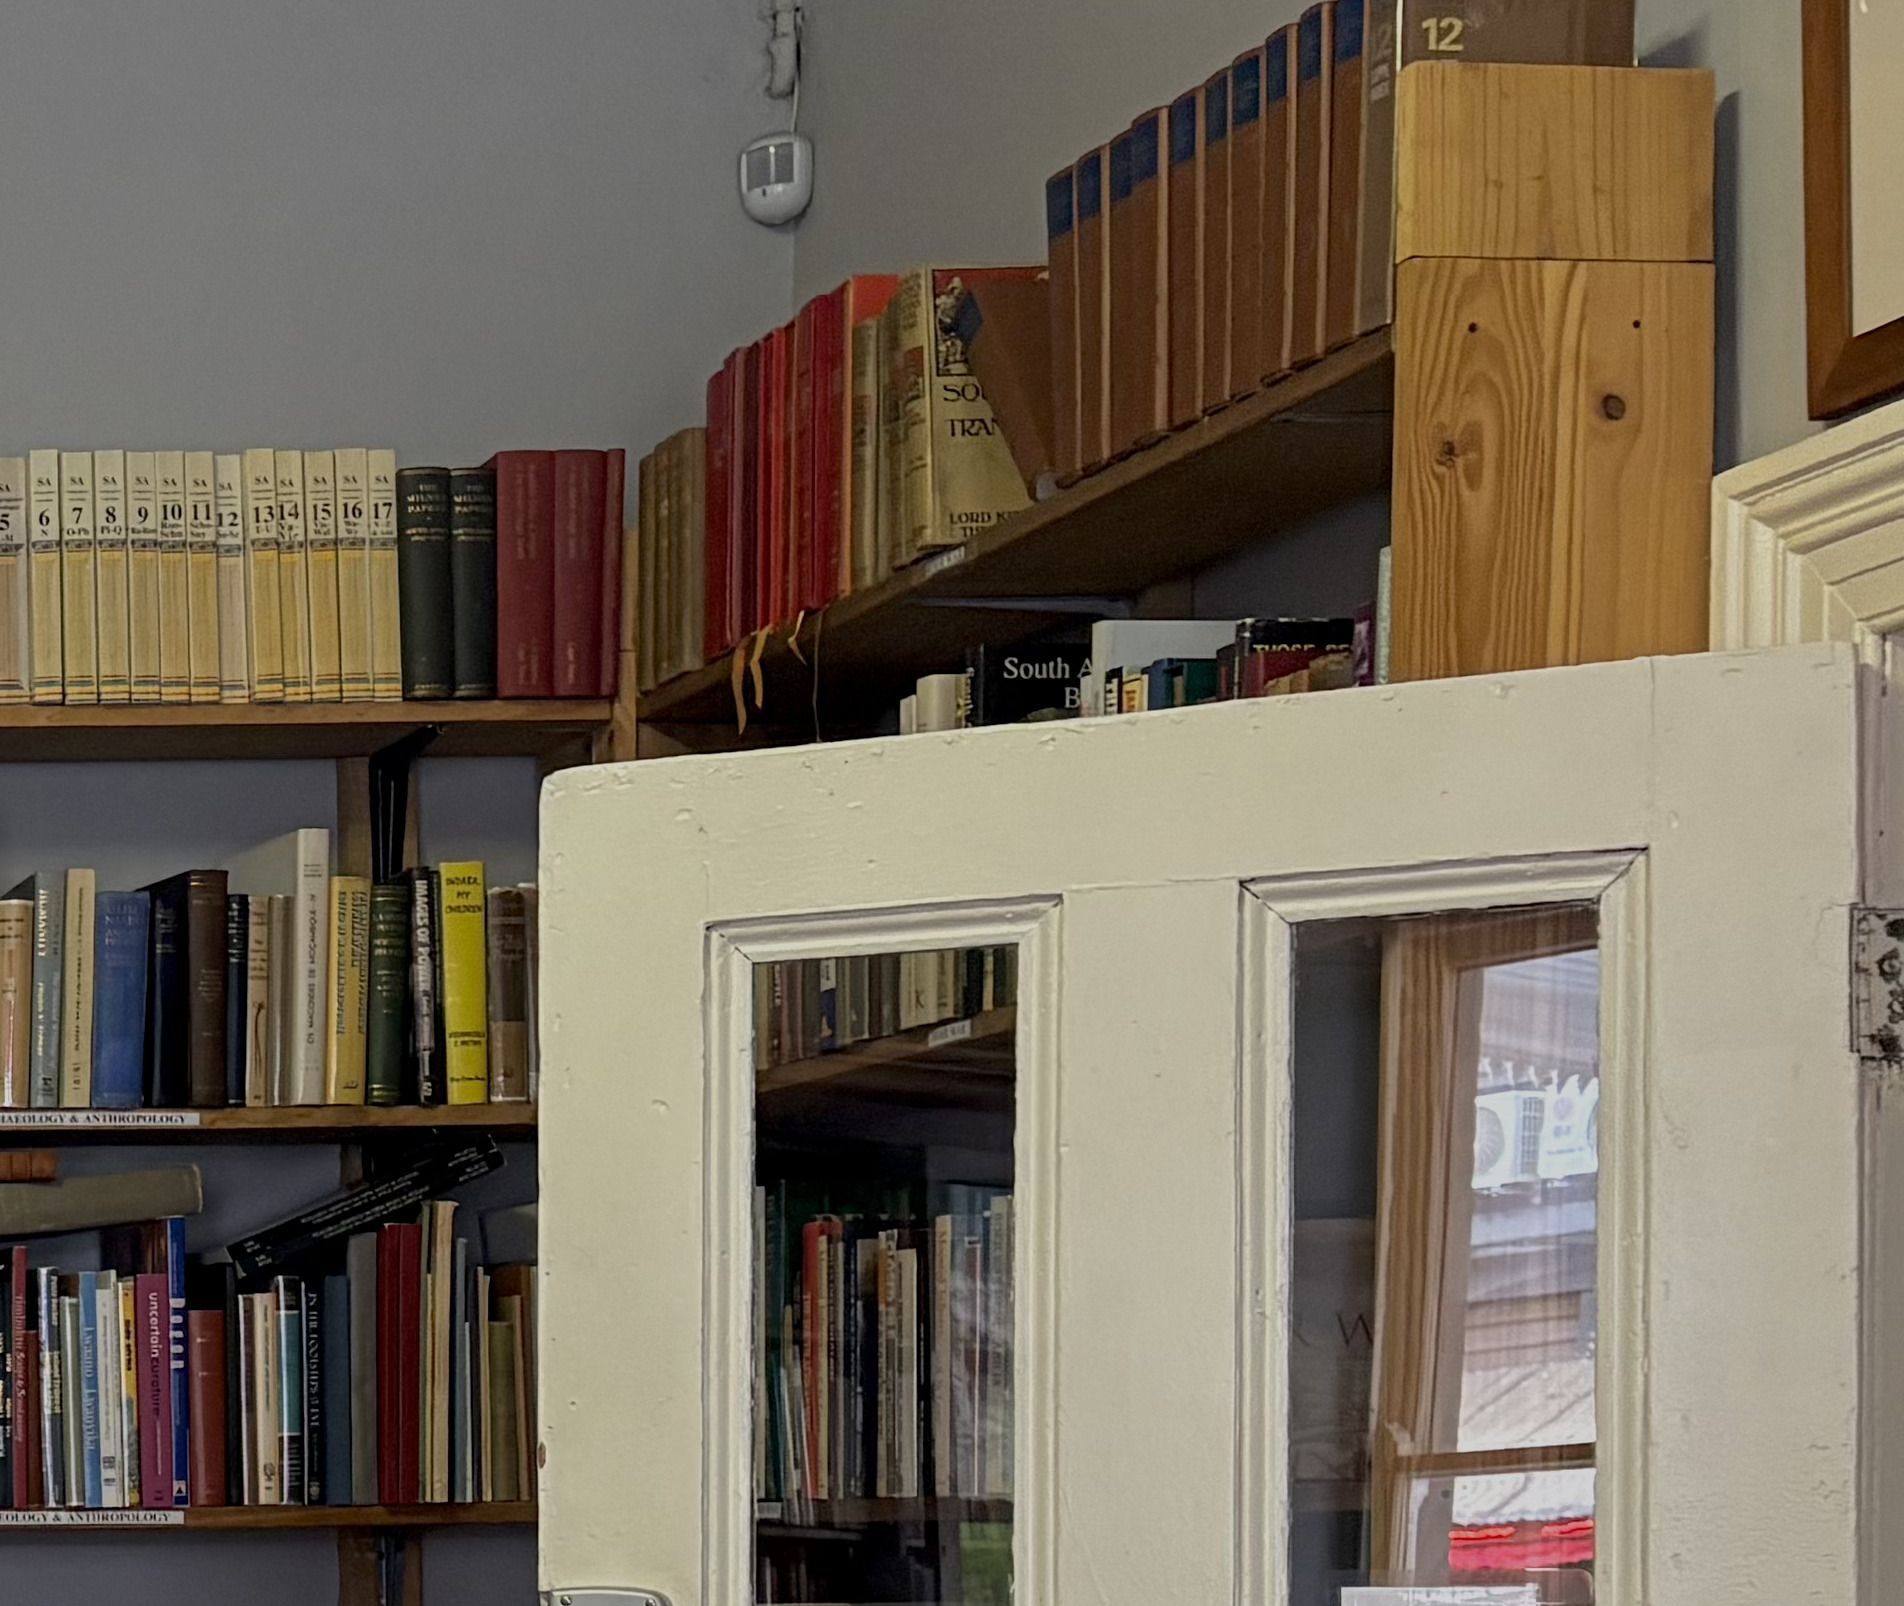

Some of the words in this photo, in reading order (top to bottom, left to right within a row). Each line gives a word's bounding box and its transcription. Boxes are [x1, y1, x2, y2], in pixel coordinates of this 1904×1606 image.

[1422, 16, 1464, 52] 12
[69, 476, 84, 486] SA
[162, 477, 177, 487] SA
[255, 476, 269, 486] SA
[343, 475, 358, 485] SA
[39, 509, 50, 527] 6
[72, 507, 83, 524] 7
[105, 505, 117, 524] 8
[137, 506, 149, 524] 9
[161, 502, 182, 521] 10
[191, 502, 212, 521] 11
[217, 512, 238, 527] 12
[253, 505, 275, 524] 13
[277, 501, 299, 521] 14
[311, 502, 331, 521] 15
[342, 501, 362, 520] 16
[372, 501, 392, 520] 17
[0, 513, 11, 531] 5
[1002, 657, 1070, 680] South
[414, 880, 428, 924] IMAGES
[415, 926, 428, 944] OF
[69, 1113, 80, 1125] &
[85, 1113, 185, 1126] ANTHROPOLOGY
[52, 1512, 62, 1524] &
[68, 1512, 170, 1524] ANTHROPOLOGY
